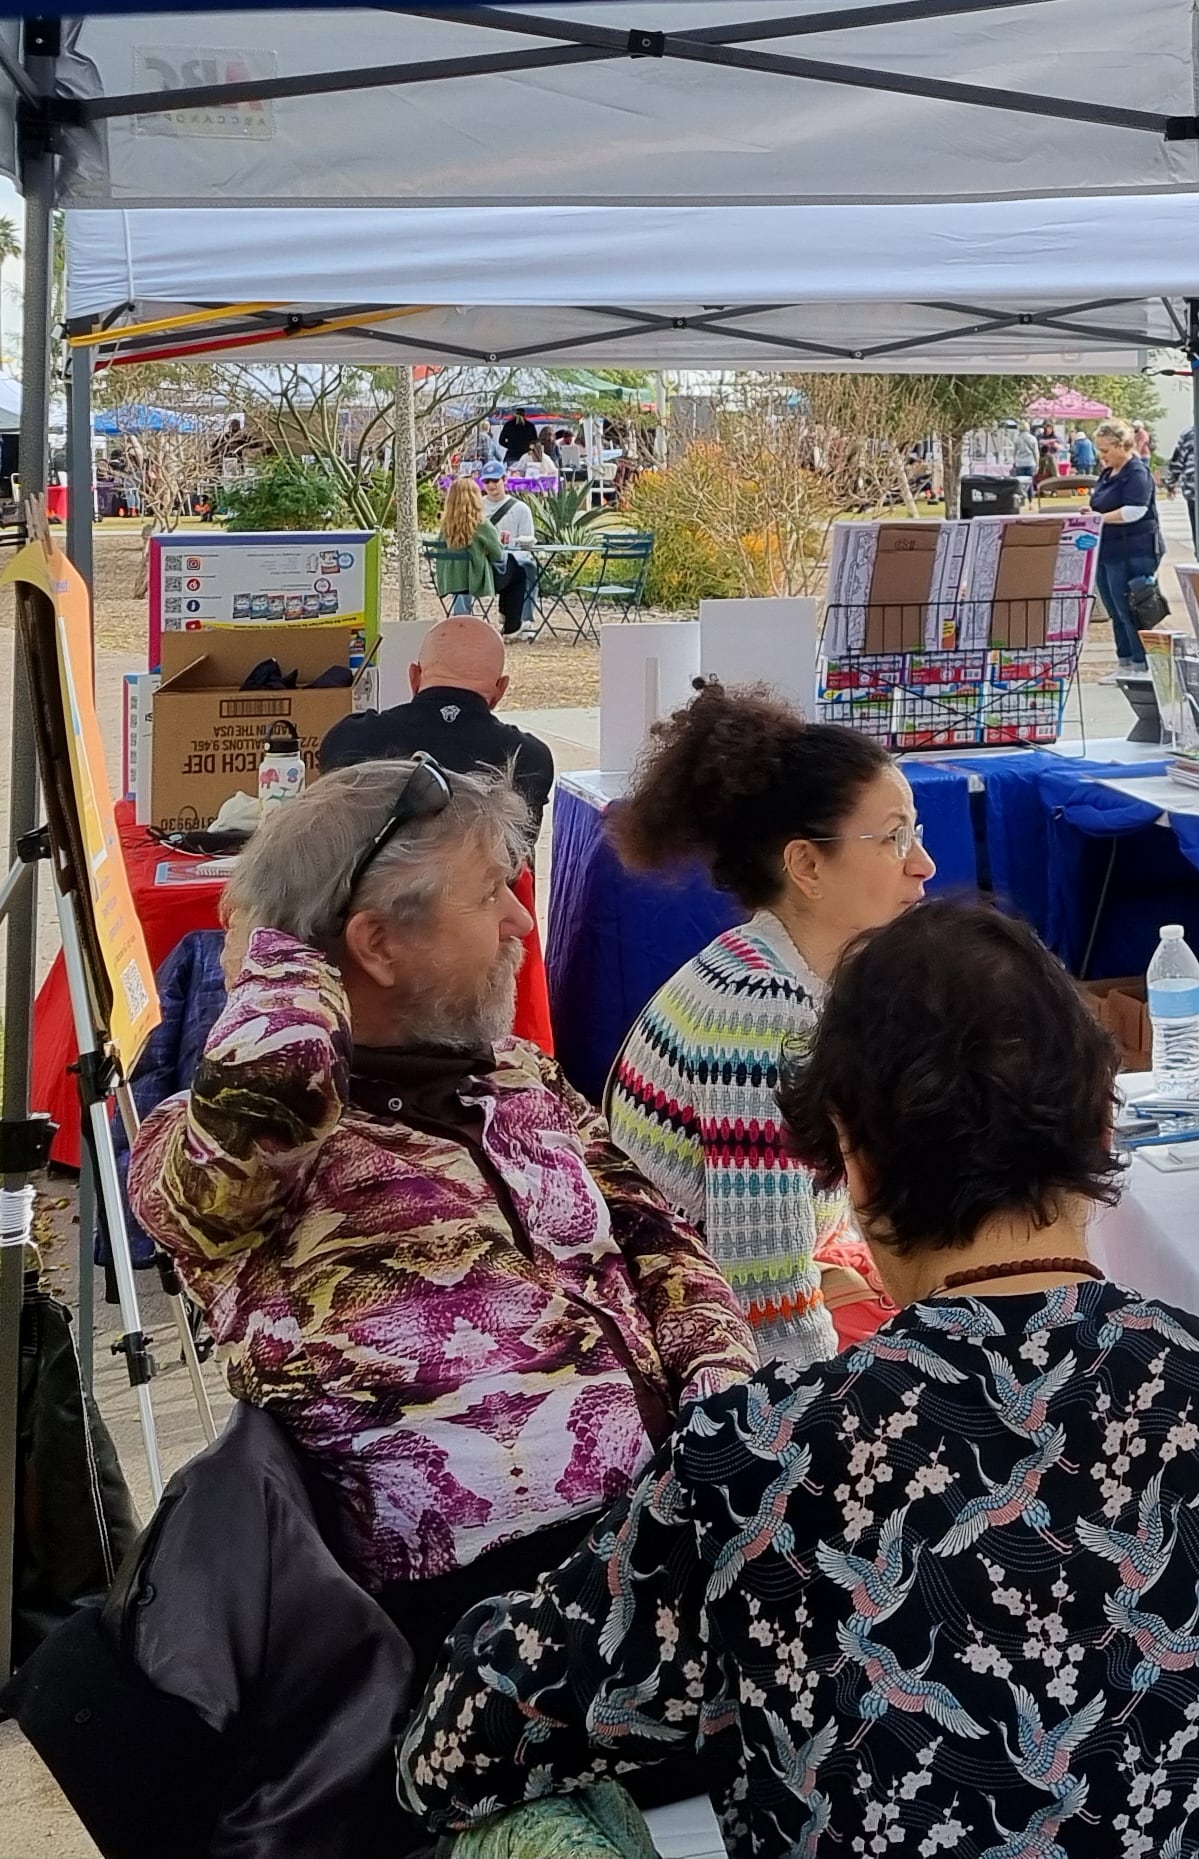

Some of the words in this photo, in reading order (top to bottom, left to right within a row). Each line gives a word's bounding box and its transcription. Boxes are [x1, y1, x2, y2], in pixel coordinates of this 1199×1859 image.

[213, 726, 235, 737] USA
[235, 725, 256, 737] THE
[182, 753, 216, 774] DEF
